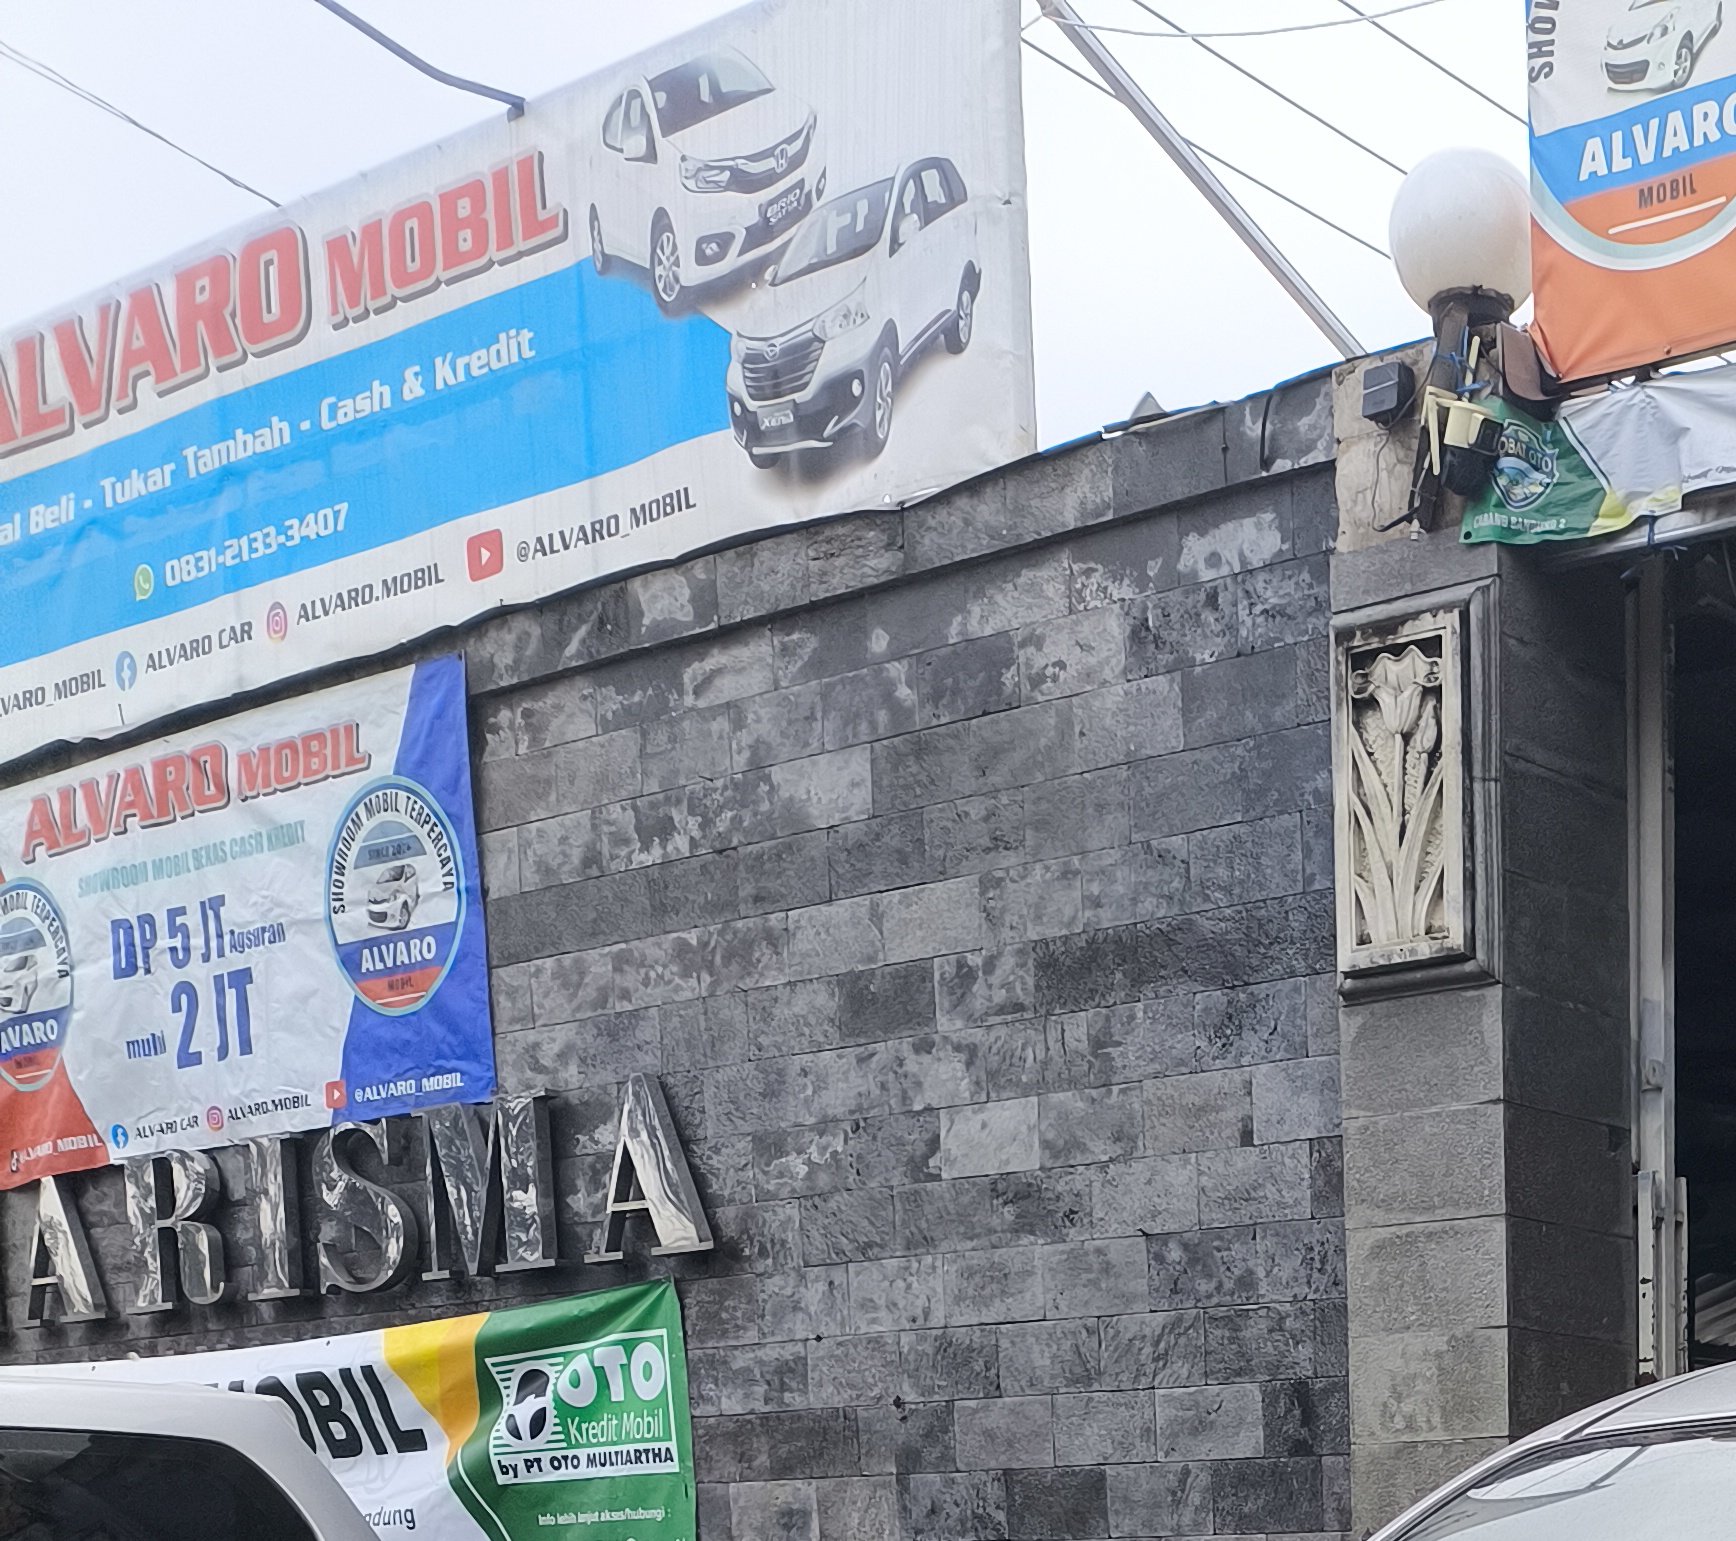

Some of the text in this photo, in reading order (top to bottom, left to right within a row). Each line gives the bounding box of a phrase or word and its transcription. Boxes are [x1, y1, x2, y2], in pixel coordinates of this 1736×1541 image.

[1637, 172, 1698, 211] MOBIL
[324, 148, 568, 330] MOBIL
[0, 513, 21, 546] al
[29, 492, 75, 536] Beli
[101, 460, 176, 509] Tukar
[182, 415, 291, 478] Tambah
[318, 377, 392, 432] Cash
[401, 370, 425, 401] &
[434, 326, 536, 388] Kredit
[164, 502, 350, 589] 0831-2133-3407
[516, 486, 698, 564] @ALVARO_MOBIL
[296, 561, 446, 627] ALVARO.MOBIL
[144, 620, 254, 675] ALVARO CAR
[0, 668, 107, 716] VARO_MOBIL
[22, 719, 372, 864] ALVARO MOBIL
[363, 789, 402, 822] MOBIL
[151, 855, 192, 881] MOBIL
[110, 912, 158, 981] DP
[166, 905, 192, 970] 5
[199, 893, 226, 964] JT
[360, 935, 438, 974] ALVARO
[171, 980, 203, 1069] 2
[213, 966, 254, 1062] JT
[134, 1114, 200, 1141] ALVARO CAR
[10, 1072, 714, 1330] ARISMA
[557, 1341, 667, 1408] OTO
[567, 1408, 664, 1445] Kredit Mobil
[497, 1446, 675, 1480] by PT OTO MULTIARTHA
[364, 1505, 416, 1531] ndung
